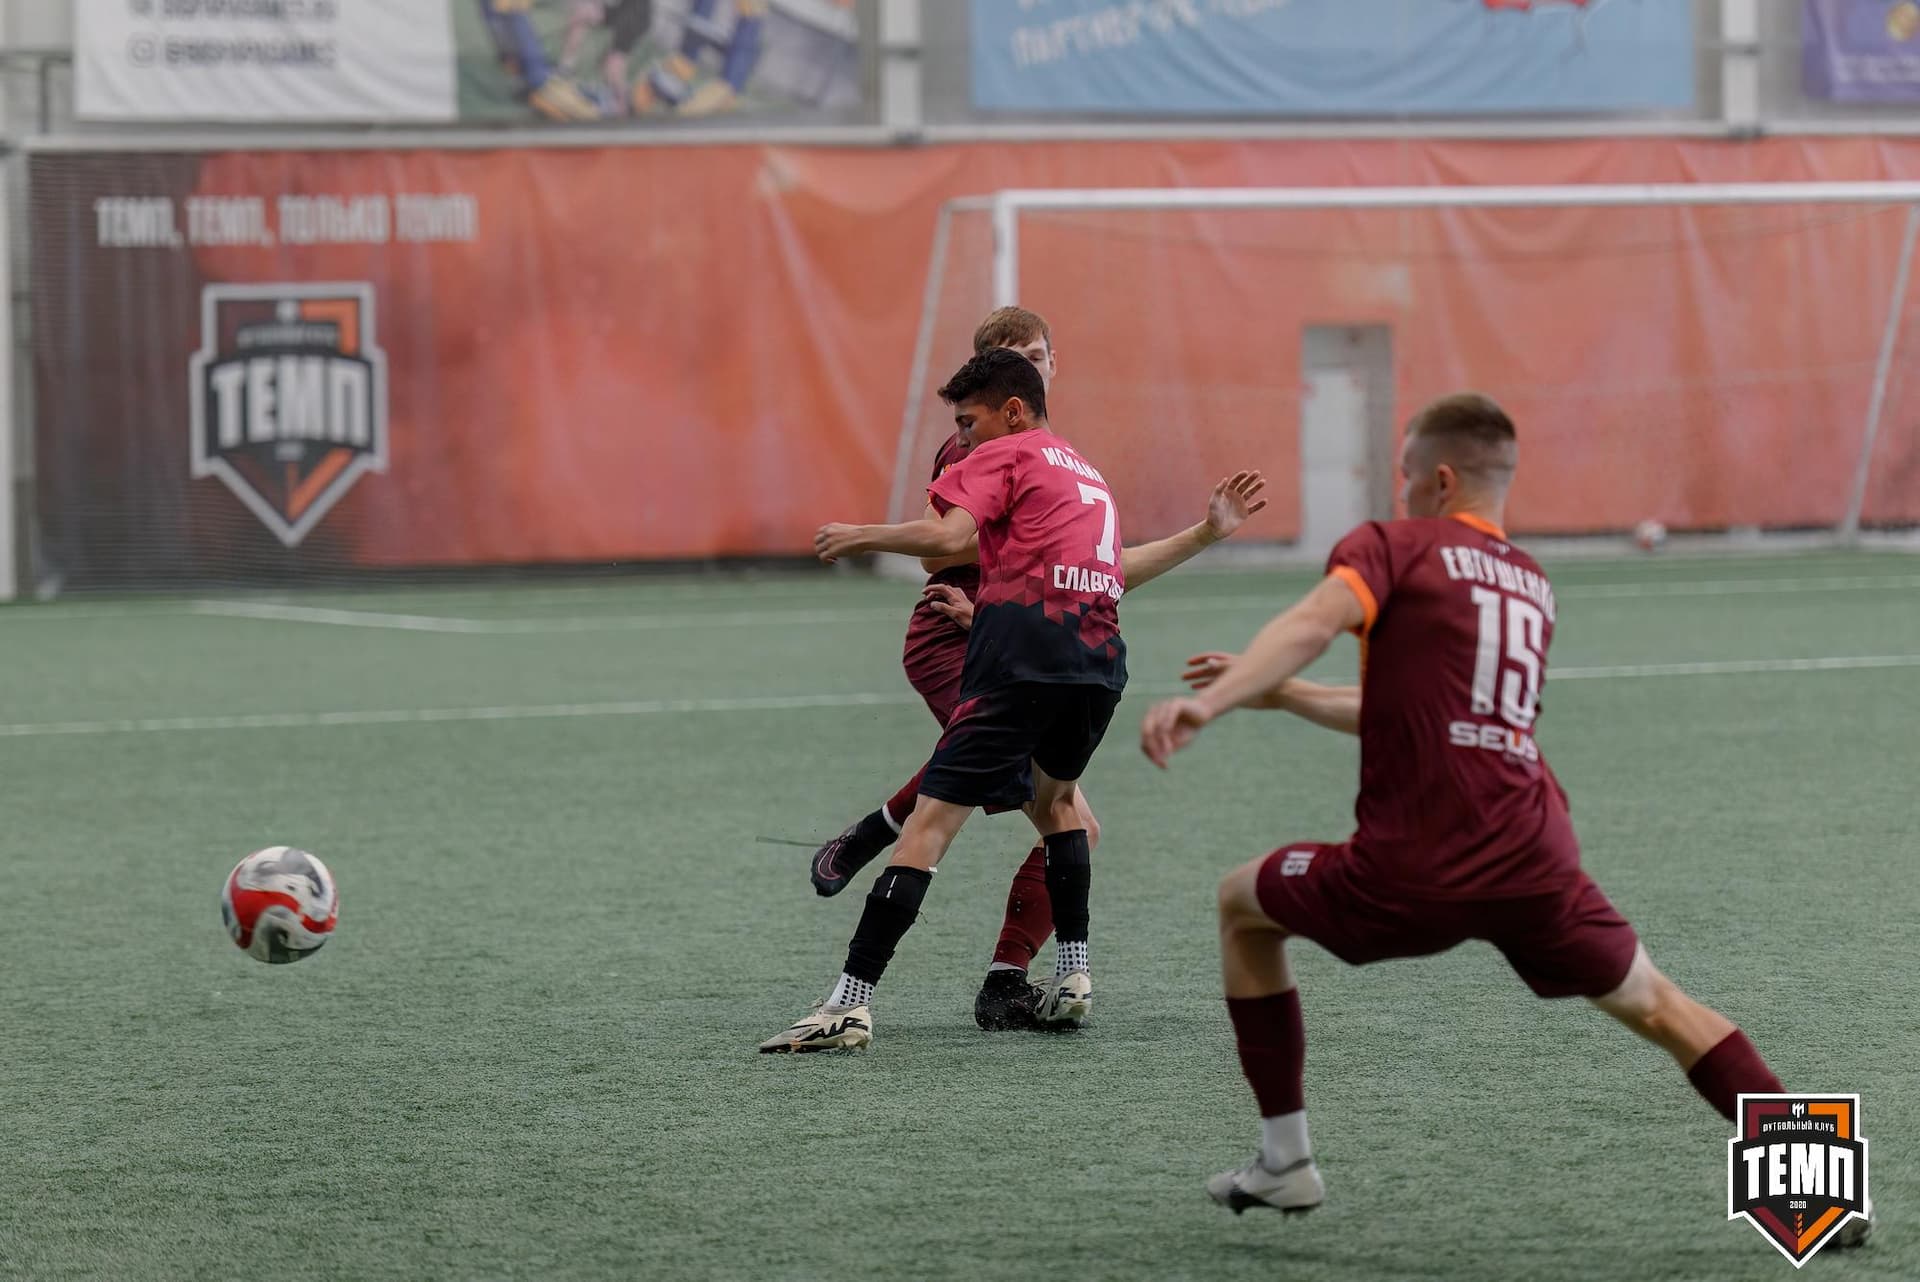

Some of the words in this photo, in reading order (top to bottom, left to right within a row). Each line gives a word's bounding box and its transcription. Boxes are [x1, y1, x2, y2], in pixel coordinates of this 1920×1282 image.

[210, 354, 369, 448] ТЕМП
[1076, 481, 1116, 566] 7
[1471, 585, 1545, 730] 15
